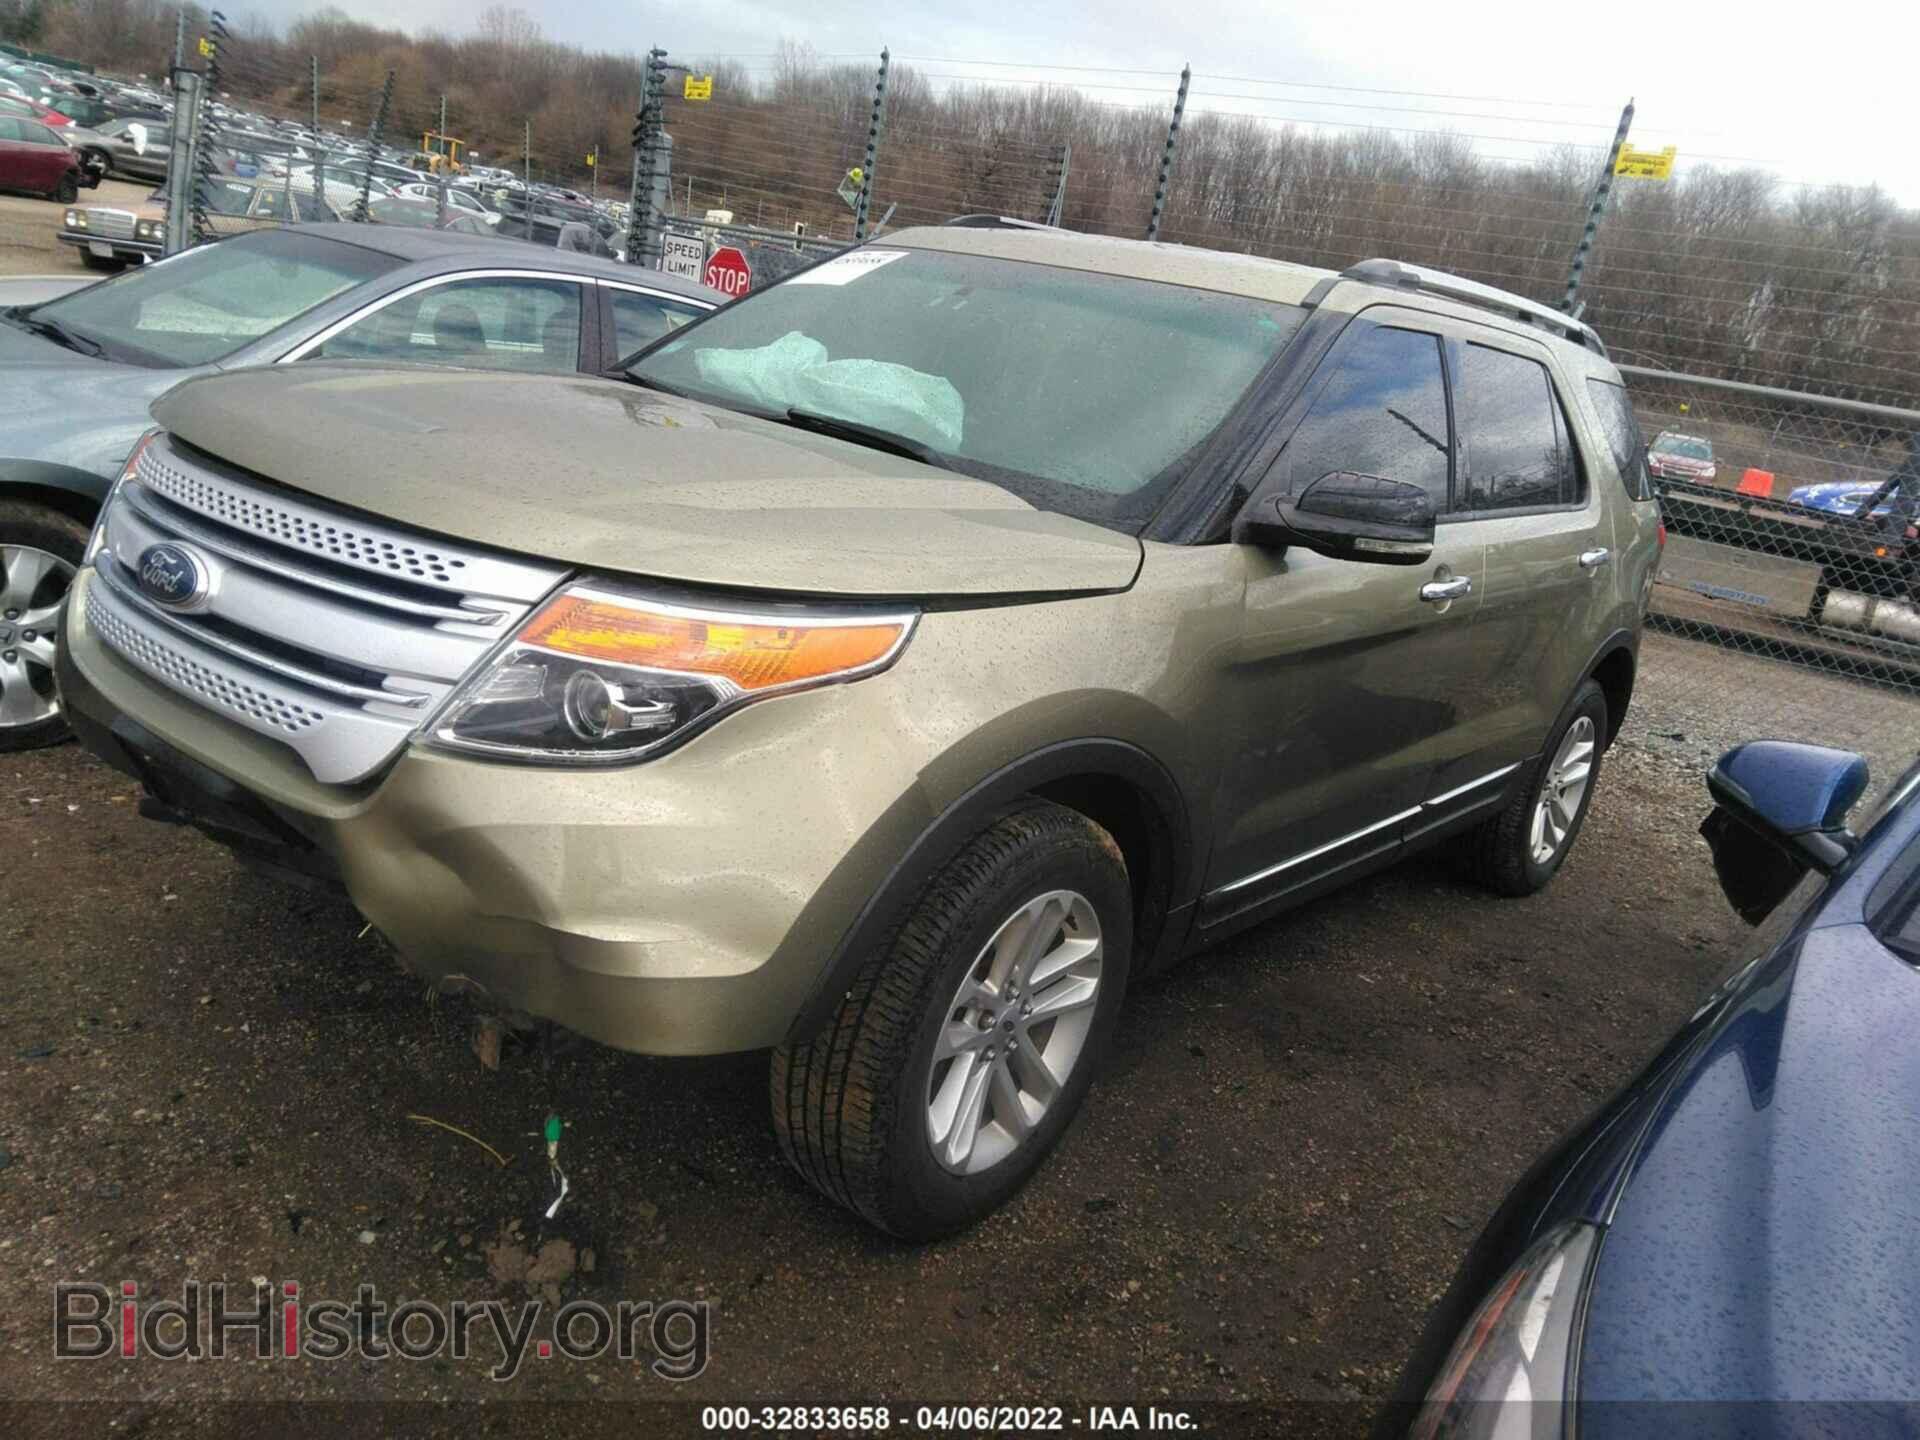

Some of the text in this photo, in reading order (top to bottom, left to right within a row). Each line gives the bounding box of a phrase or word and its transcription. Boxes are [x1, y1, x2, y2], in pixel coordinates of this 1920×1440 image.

[666, 242, 702, 260] SPEED
[667, 261, 697, 277] LIMIT
[706, 265, 748, 295] STOP
[143, 550, 184, 593] Ford
